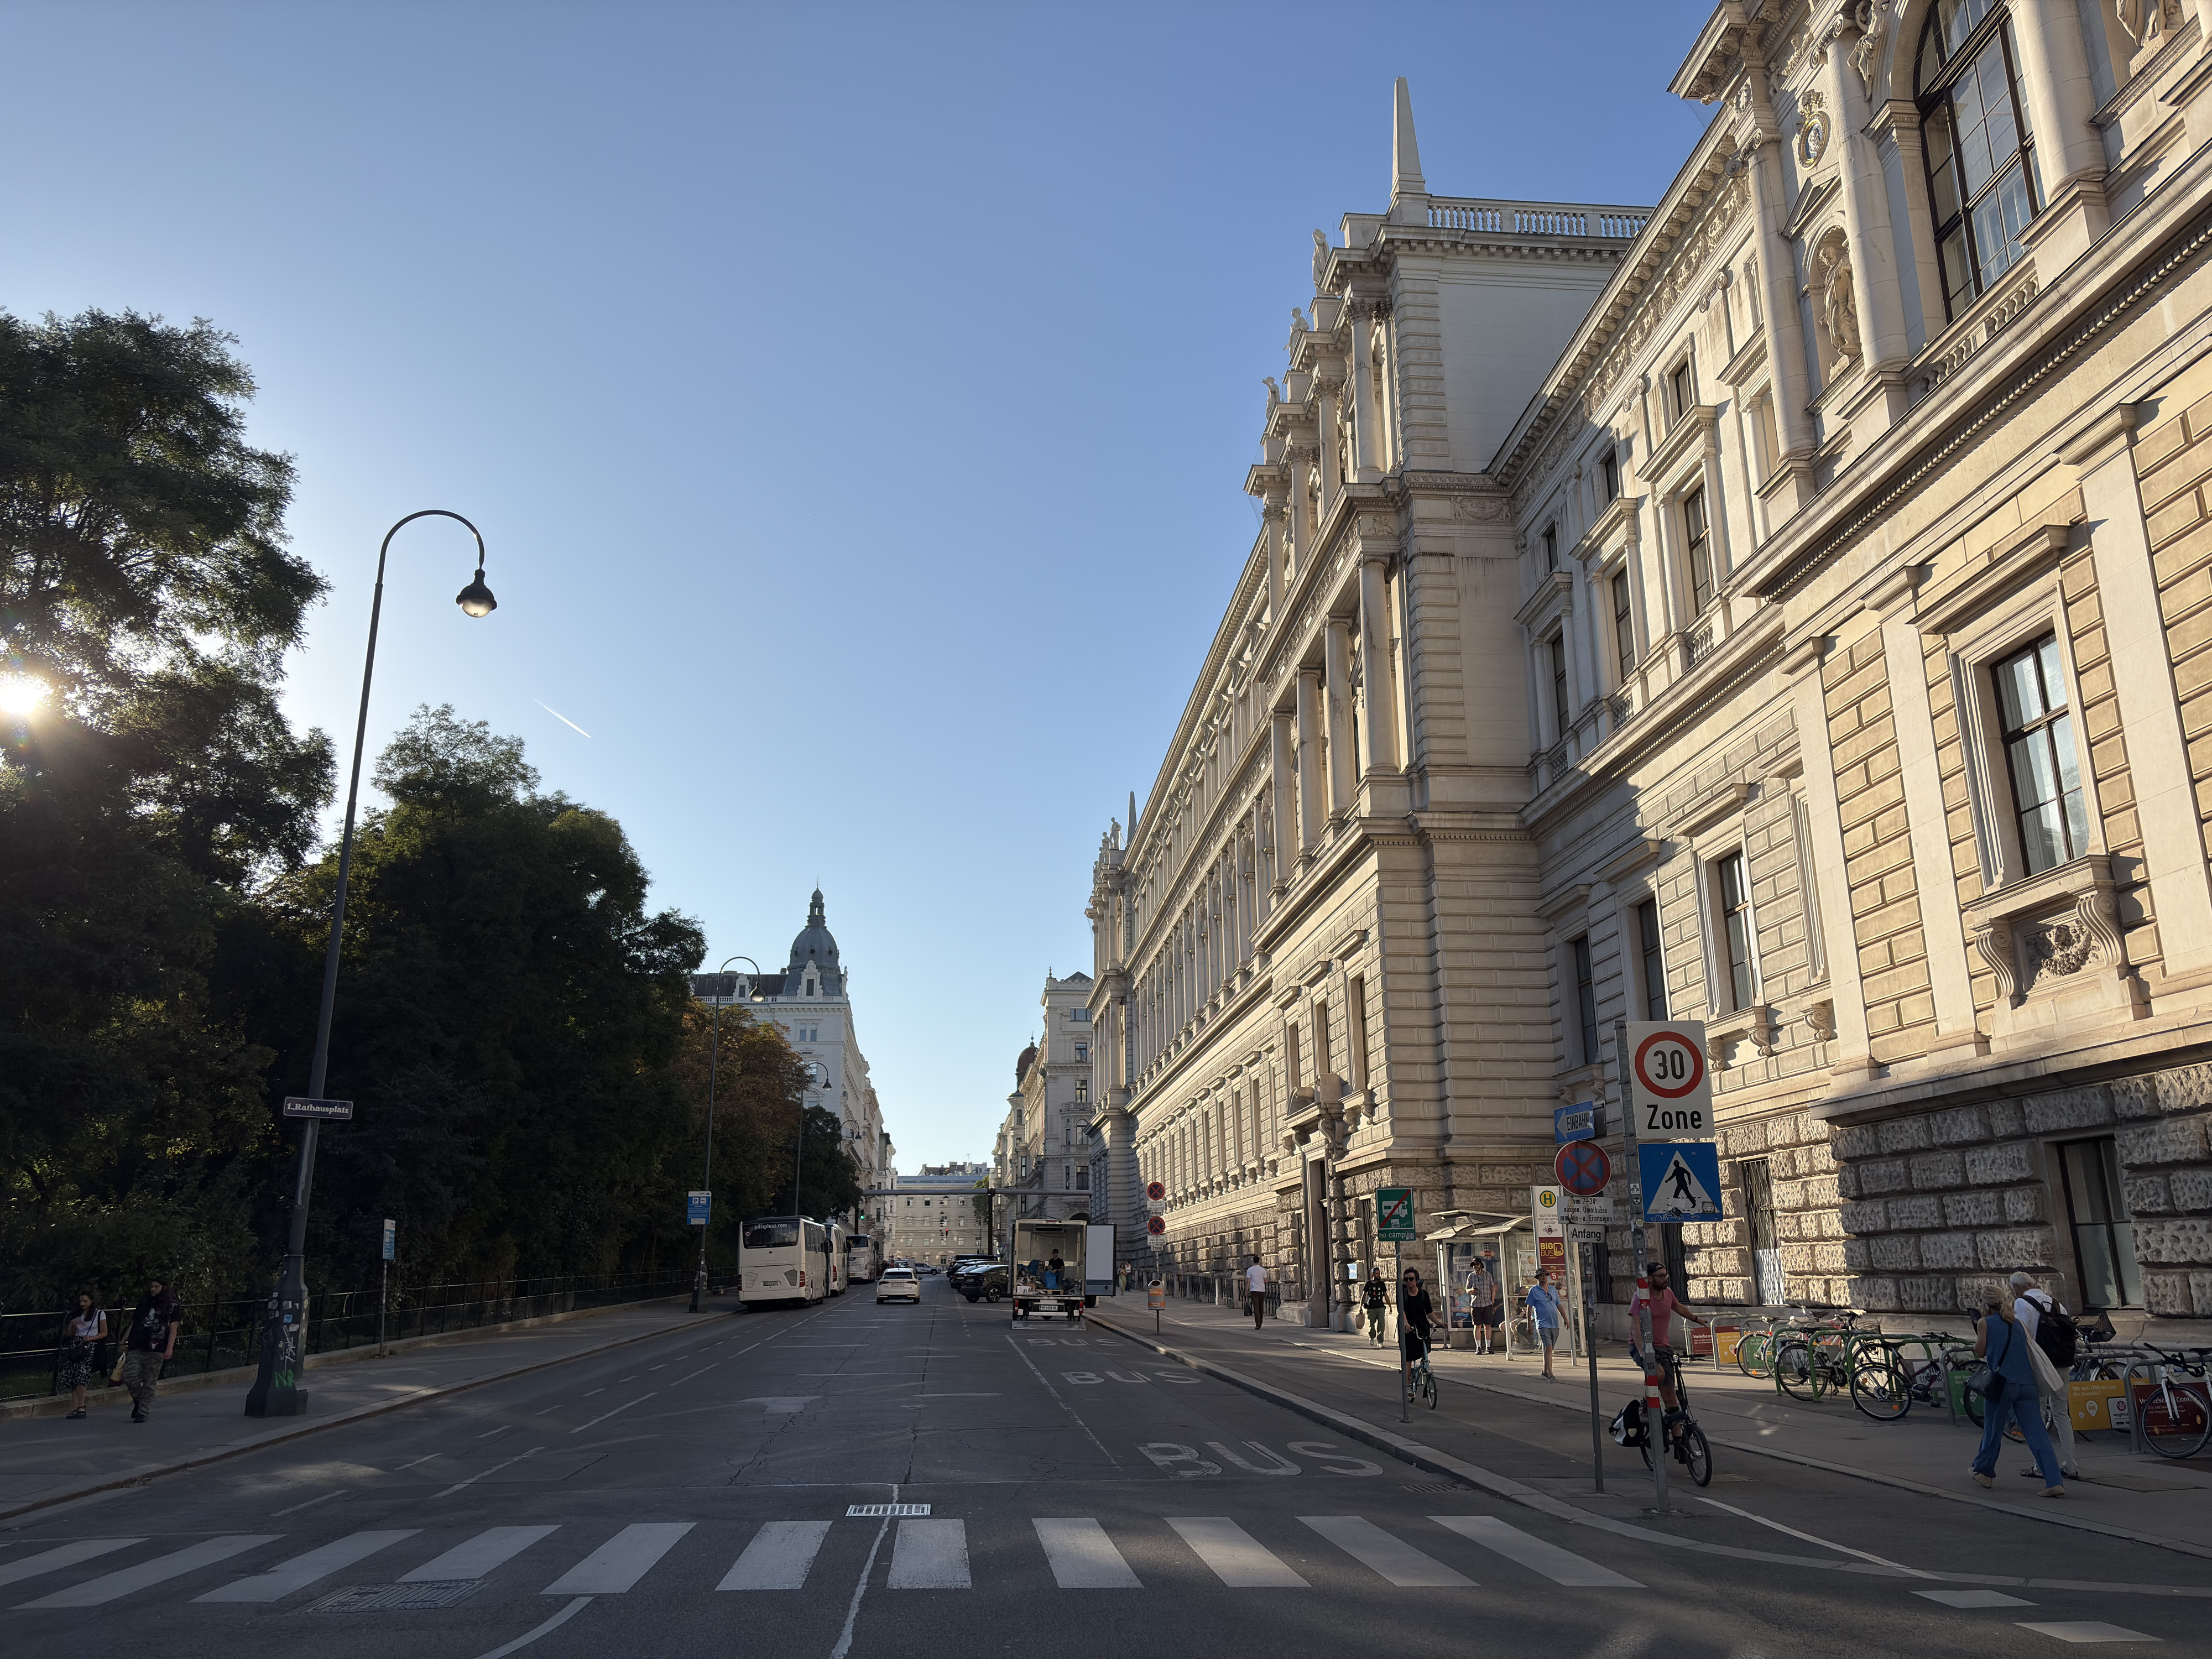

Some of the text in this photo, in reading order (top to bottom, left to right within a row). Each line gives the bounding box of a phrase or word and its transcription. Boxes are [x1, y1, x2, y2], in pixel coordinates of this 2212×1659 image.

[2135, 44, 2159, 70] EUCLIDES
[1653, 1050, 1685, 1079] 30
[295, 1103, 349, 1114] Rathausplatz
[1646, 1104, 1702, 1130] Zone
[1543, 1193, 1552, 1204] H
[1589, 1214, 1612, 1223] Einsteigen
[1572, 1228, 1601, 1241] Anfang
[1060, 1371, 1202, 1385] BUS
[1134, 1441, 1384, 1479] BUS
